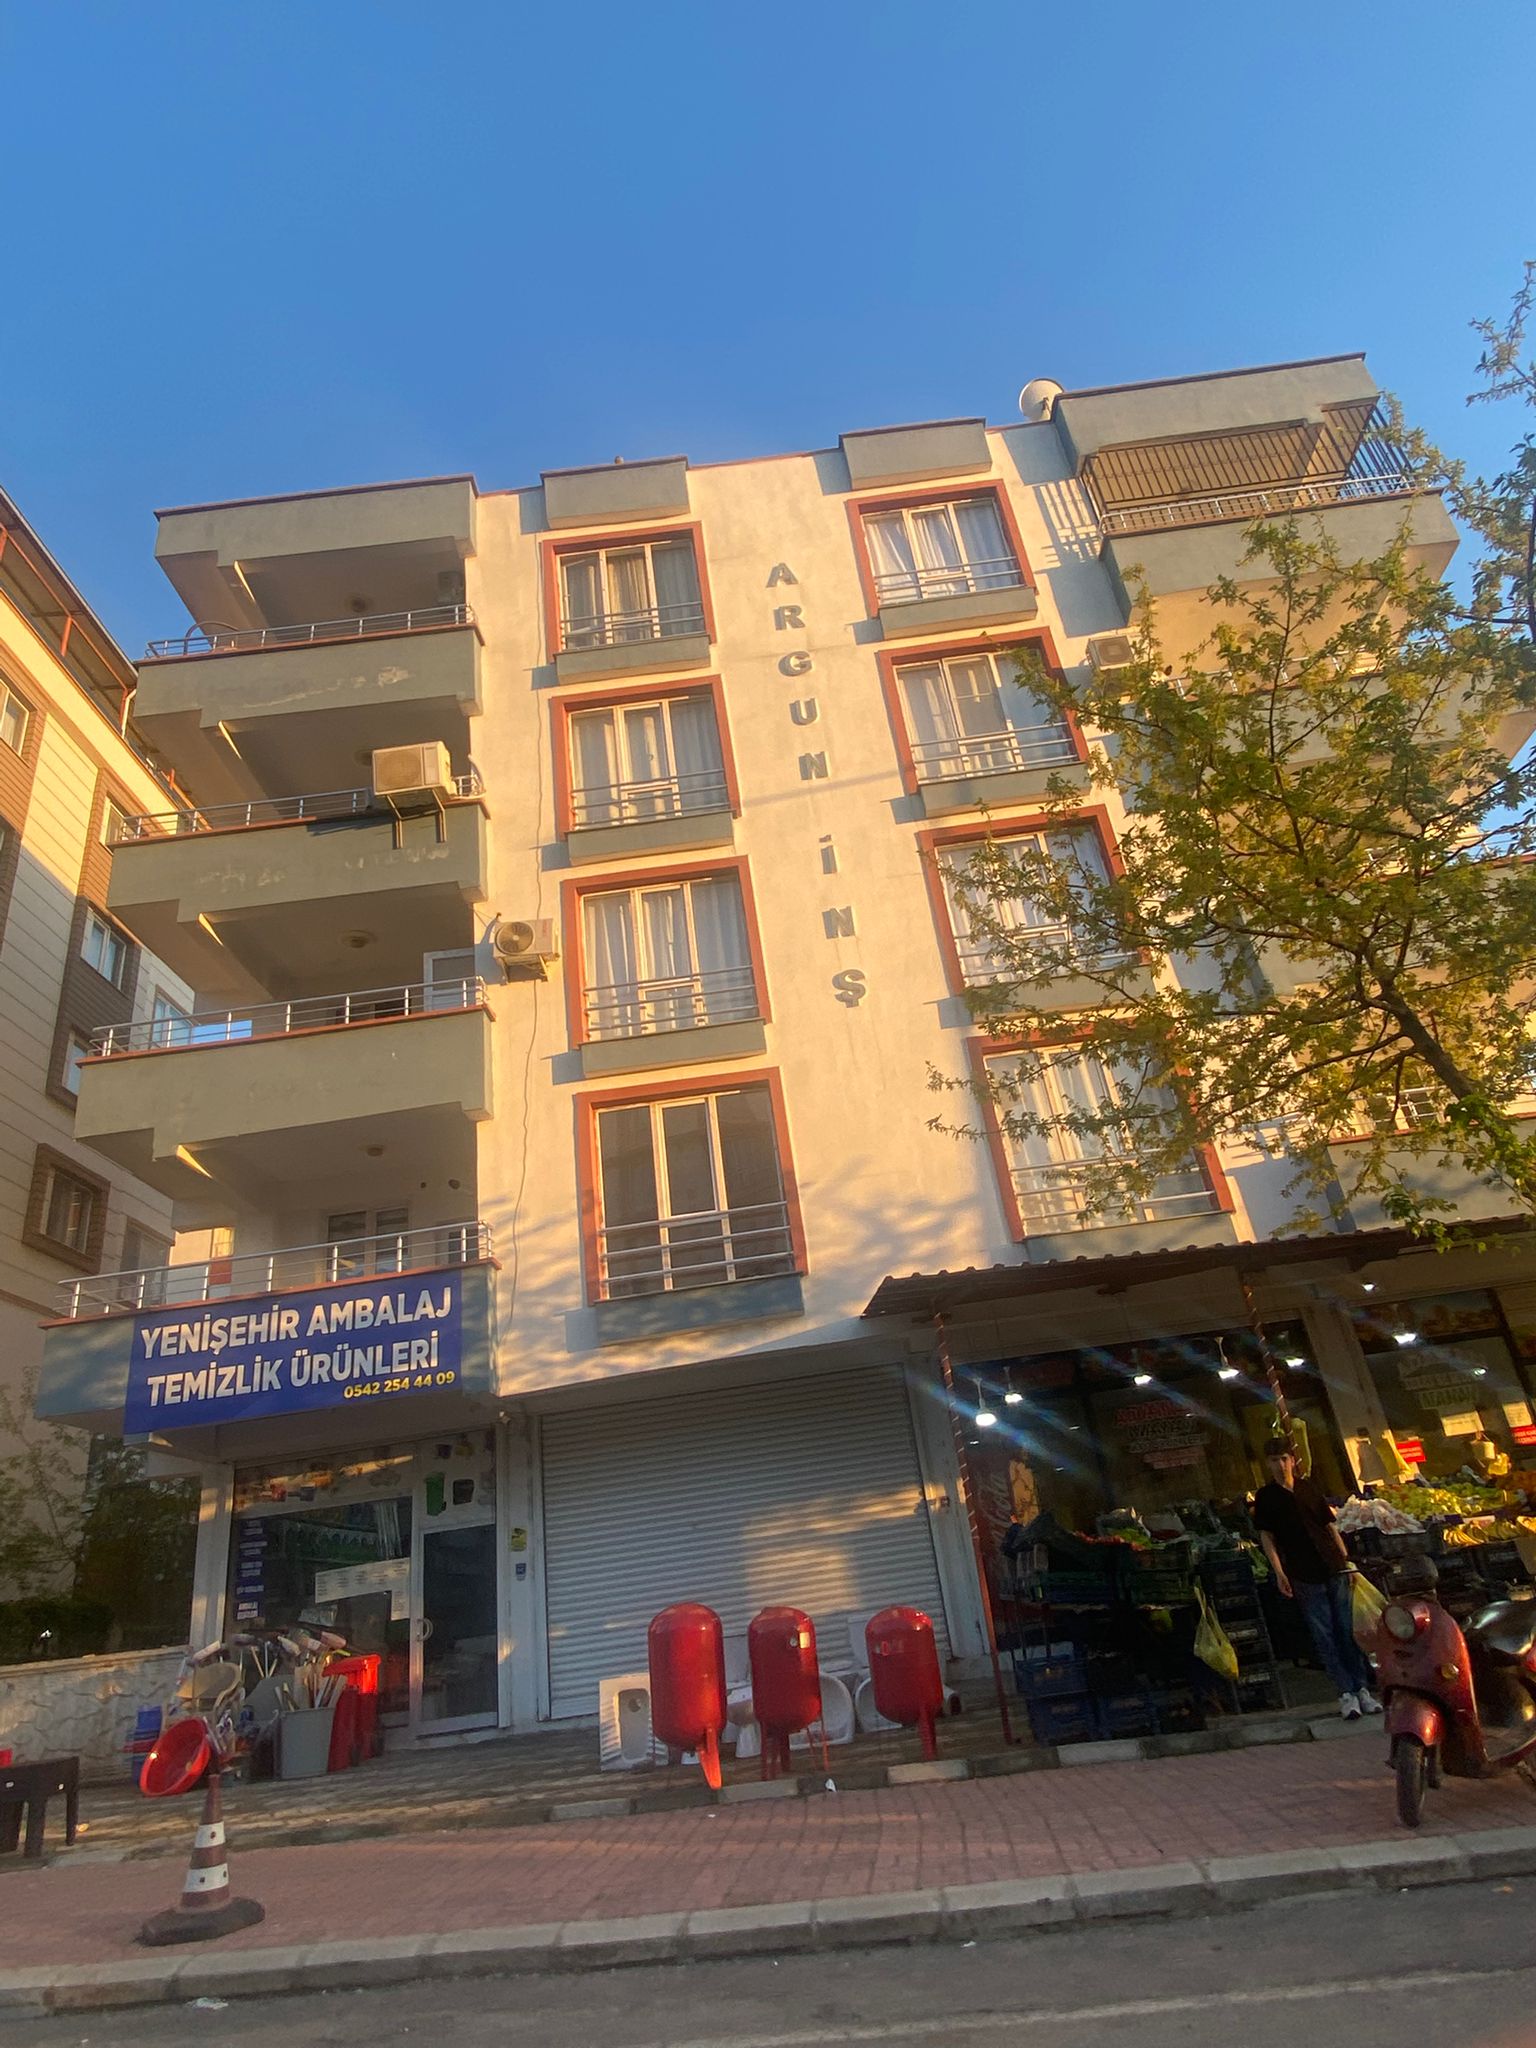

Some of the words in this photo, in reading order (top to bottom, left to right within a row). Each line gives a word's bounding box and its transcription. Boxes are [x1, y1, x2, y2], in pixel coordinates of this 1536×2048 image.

[766, 562, 829, 781] ARGUN
[141, 1304, 300, 1359] YENİŞEHİR
[306, 1287, 452, 1337] AMBALAJ
[147, 1355, 284, 1407] TEMİZLİK
[290, 1331, 440, 1387] ÜRÜNLERİ
[343, 1382, 380, 1399] 0542
[383, 1377, 410, 1393] 254
[413, 1374, 433, 1388] 44
[436, 1370, 456, 1385] 09
